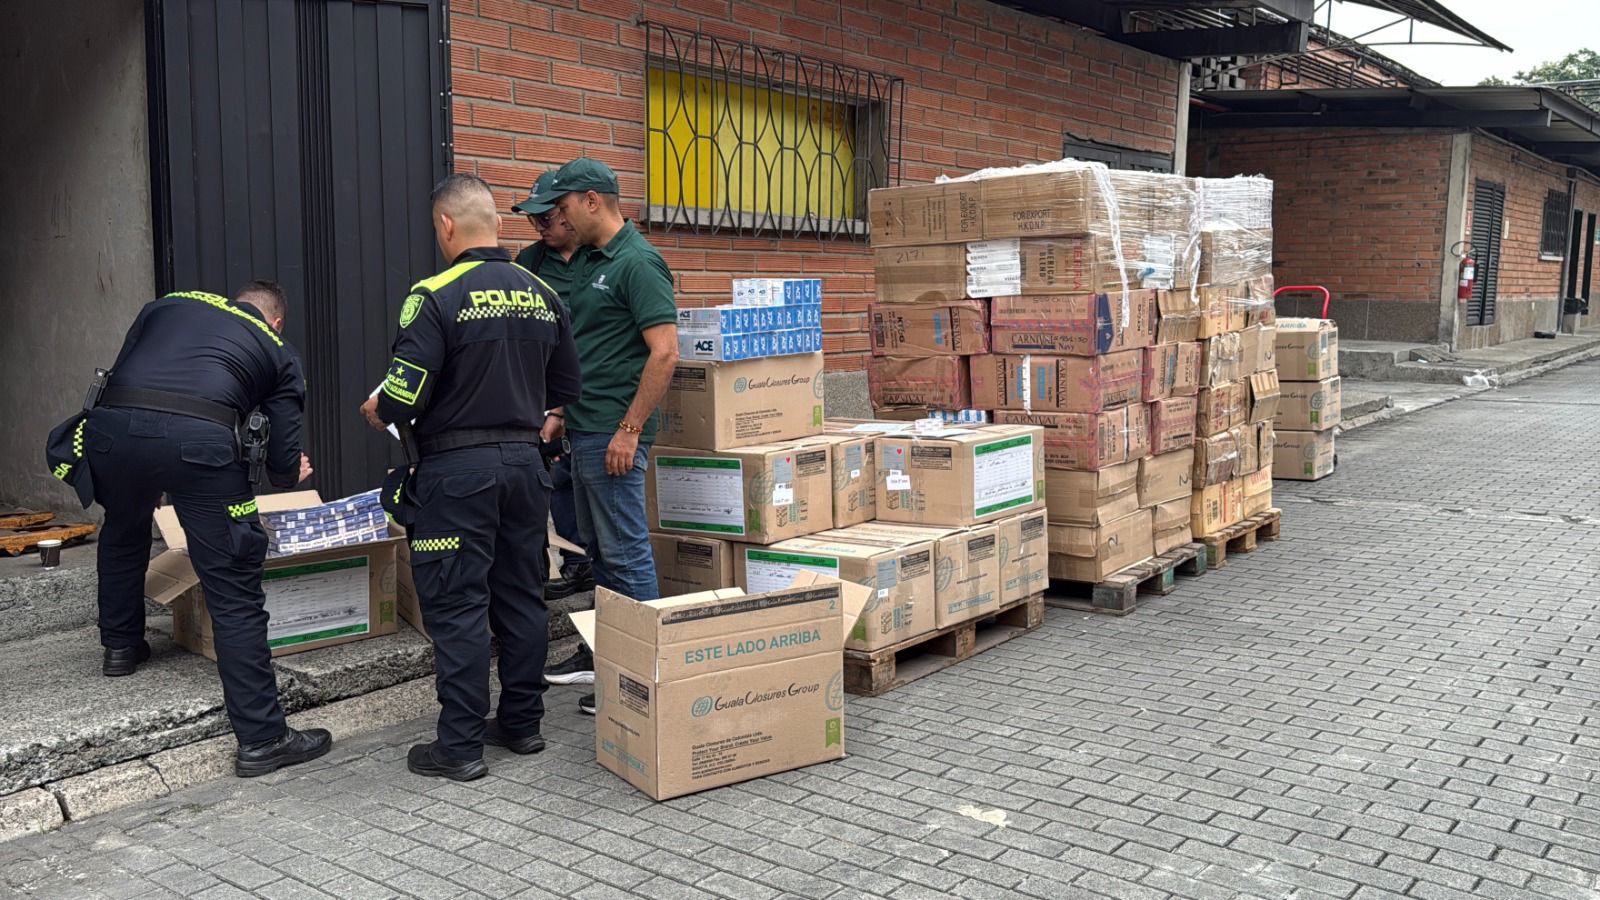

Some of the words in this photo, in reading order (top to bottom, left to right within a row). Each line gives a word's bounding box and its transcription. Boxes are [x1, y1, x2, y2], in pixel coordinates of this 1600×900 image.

[469, 286, 547, 309] POLICÍA
[694, 340, 713, 351] ACE
[829, 600, 836, 610] 2
[685, 646, 722, 664] ESTE
[726, 639, 766, 657] LADO
[769, 629, 821, 649] ARRIBA
[714, 696, 744, 711] Guala
[745, 689, 786, 705] Closures
[788, 683, 820, 696] Group
